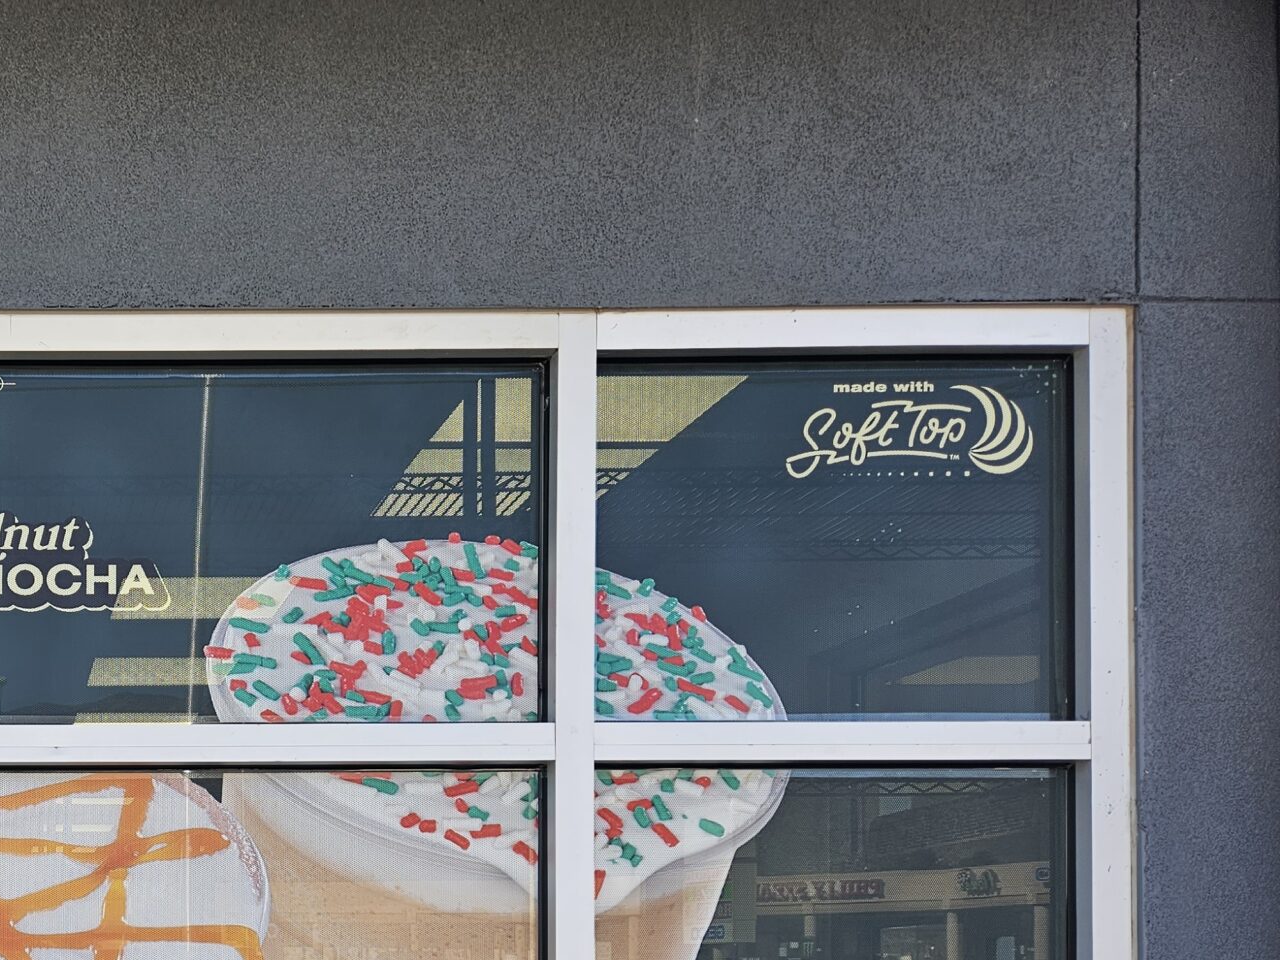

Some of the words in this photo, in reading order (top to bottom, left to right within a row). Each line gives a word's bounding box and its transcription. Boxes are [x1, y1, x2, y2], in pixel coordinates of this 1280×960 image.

[833, 382, 887, 393] made
[893, 381, 934, 393] with
[786, 408, 899, 478] Soft
[872, 400, 971, 448] Top
